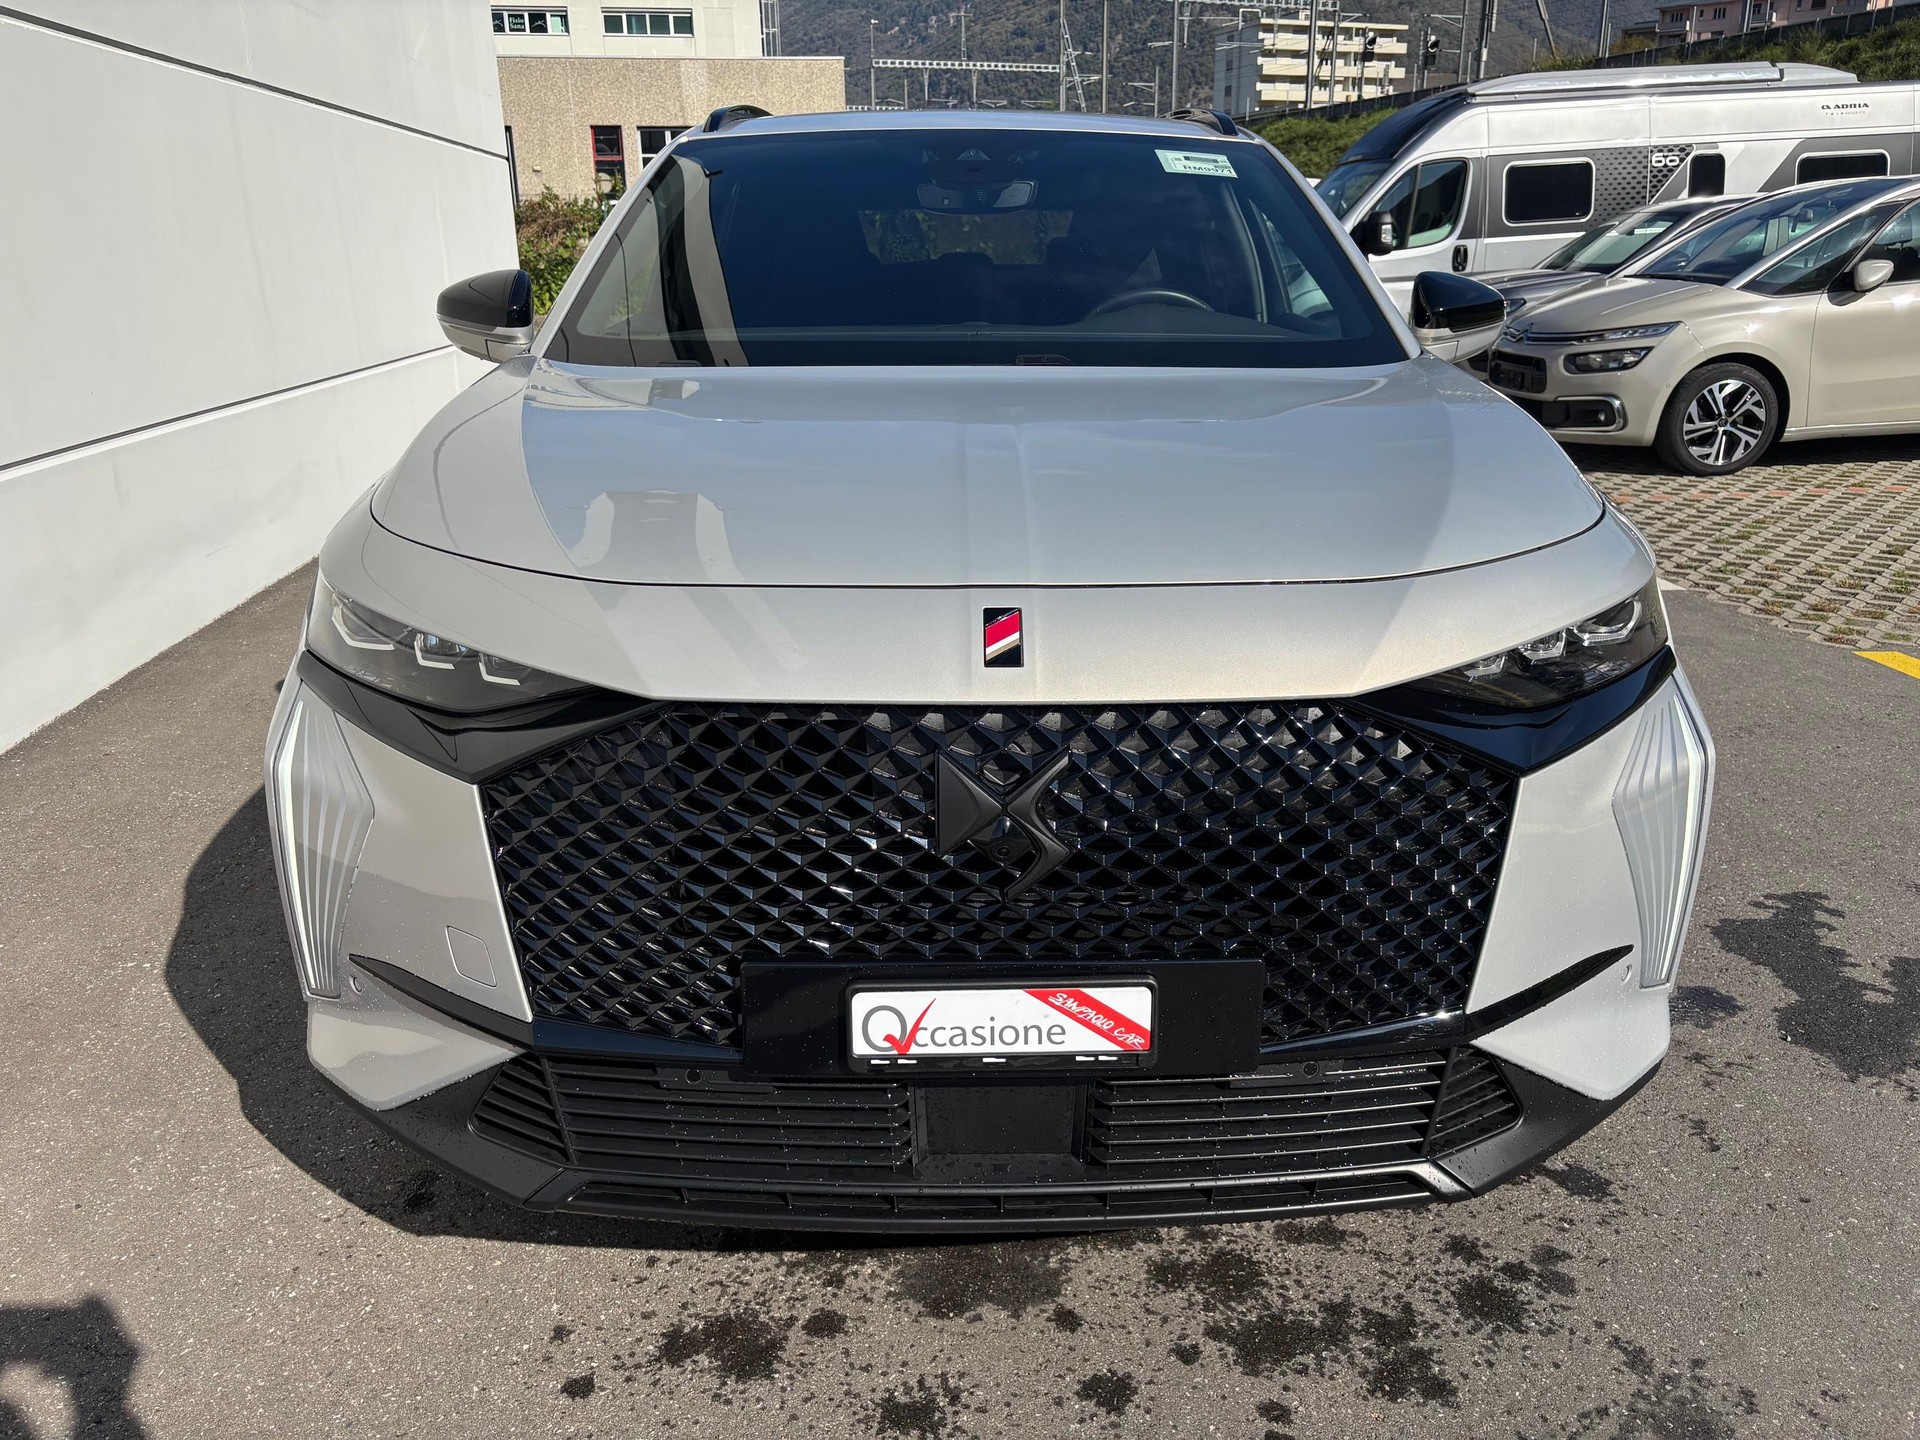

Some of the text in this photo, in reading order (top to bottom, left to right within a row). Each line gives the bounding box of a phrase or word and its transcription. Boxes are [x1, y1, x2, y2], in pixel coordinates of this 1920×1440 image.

[1651, 153, 1680, 167] 60
[1048, 993, 1145, 1050] SANPAOLO CAR
